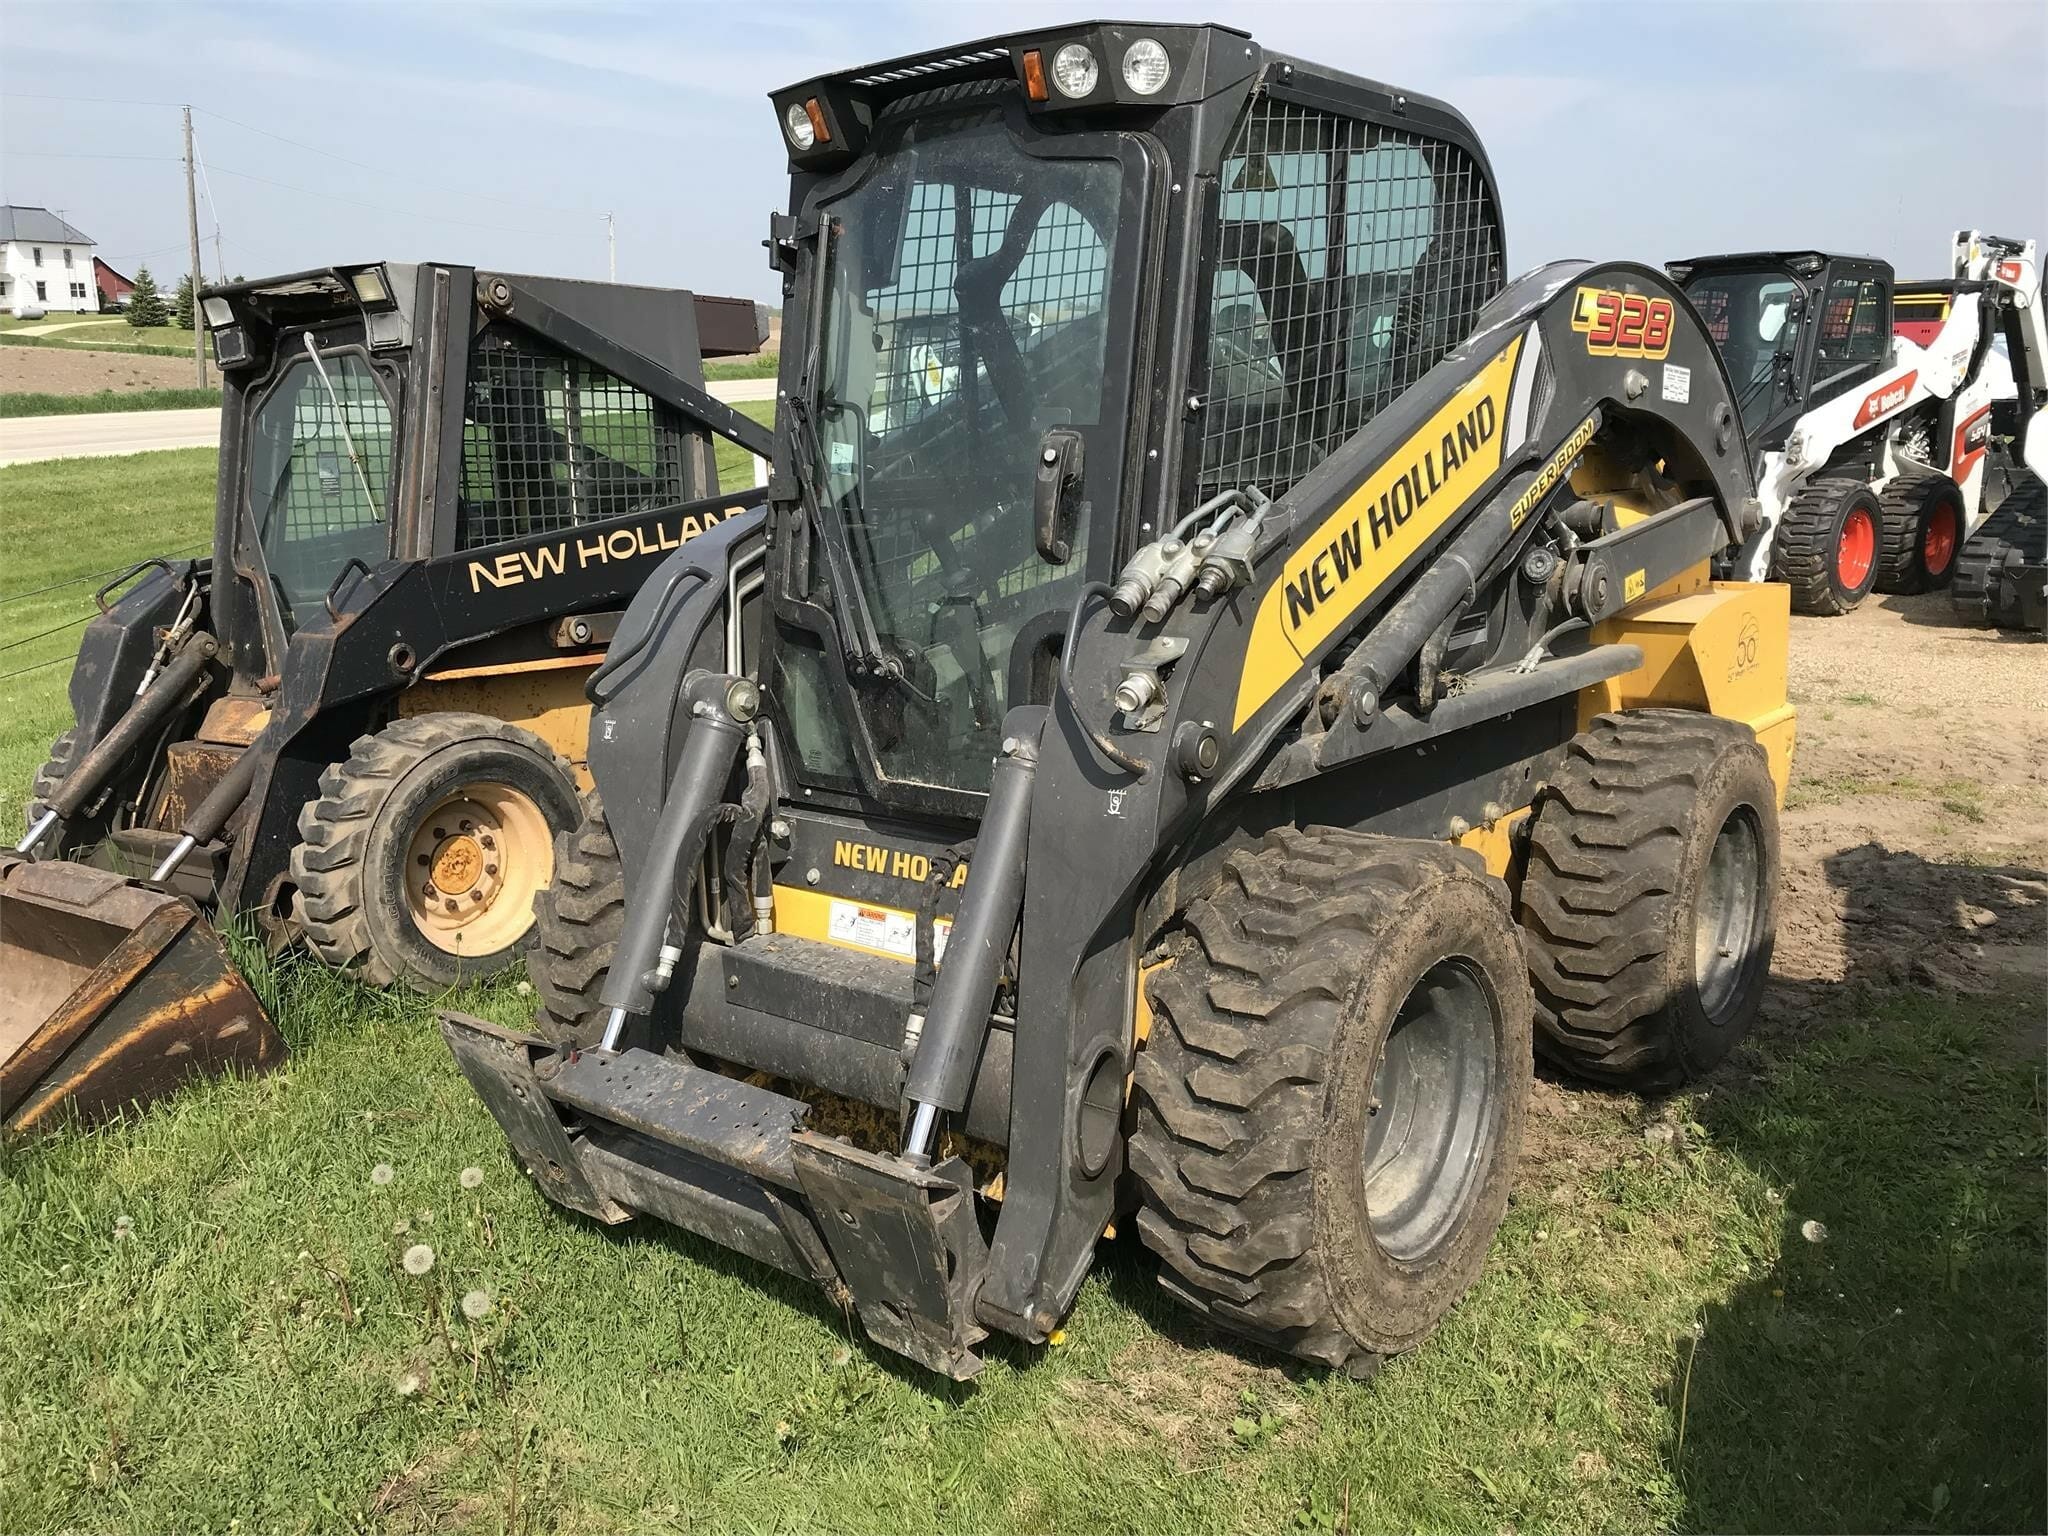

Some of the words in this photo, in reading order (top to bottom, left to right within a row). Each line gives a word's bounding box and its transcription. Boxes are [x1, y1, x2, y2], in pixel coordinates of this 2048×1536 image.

[1573, 287, 1674, 358] L328
[1511, 463, 1556, 529] SUPER
[1556, 418, 1594, 474] BOOM
[1284, 519, 1361, 631] NEW
[1367, 395, 1496, 552] HOLLAND
[468, 543, 567, 593] NEW
[834, 840, 889, 874] NEW
